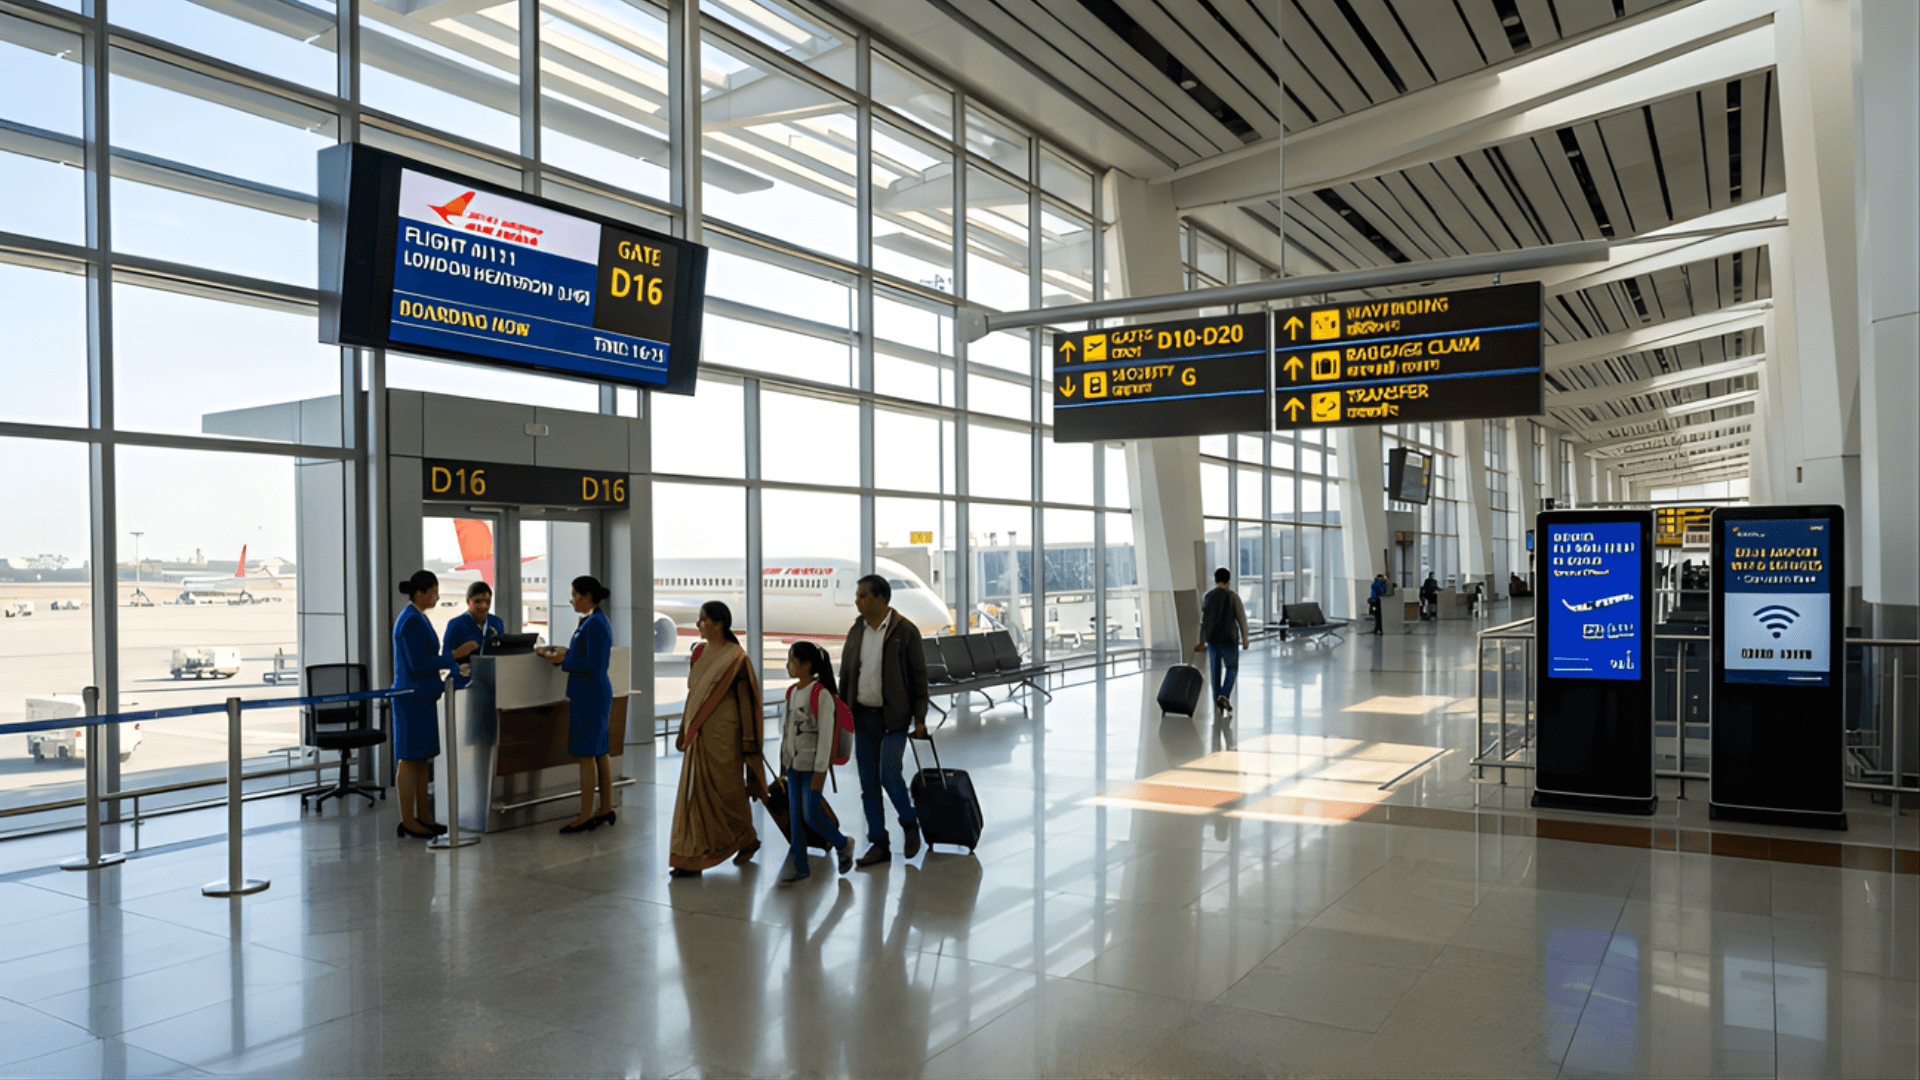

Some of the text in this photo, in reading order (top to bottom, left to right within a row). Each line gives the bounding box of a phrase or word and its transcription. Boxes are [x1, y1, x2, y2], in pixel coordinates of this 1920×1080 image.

[404, 249, 471, 278] LONDON
[618, 240, 662, 267] GATE
[610, 266, 664, 306] D16
[1157, 323, 1244, 350] D10-D20
[1427, 336, 1481, 355] CLAIM
[1181, 367, 1197, 387] G
[431, 466, 487, 496] D16
[582, 476, 625, 503] D16
